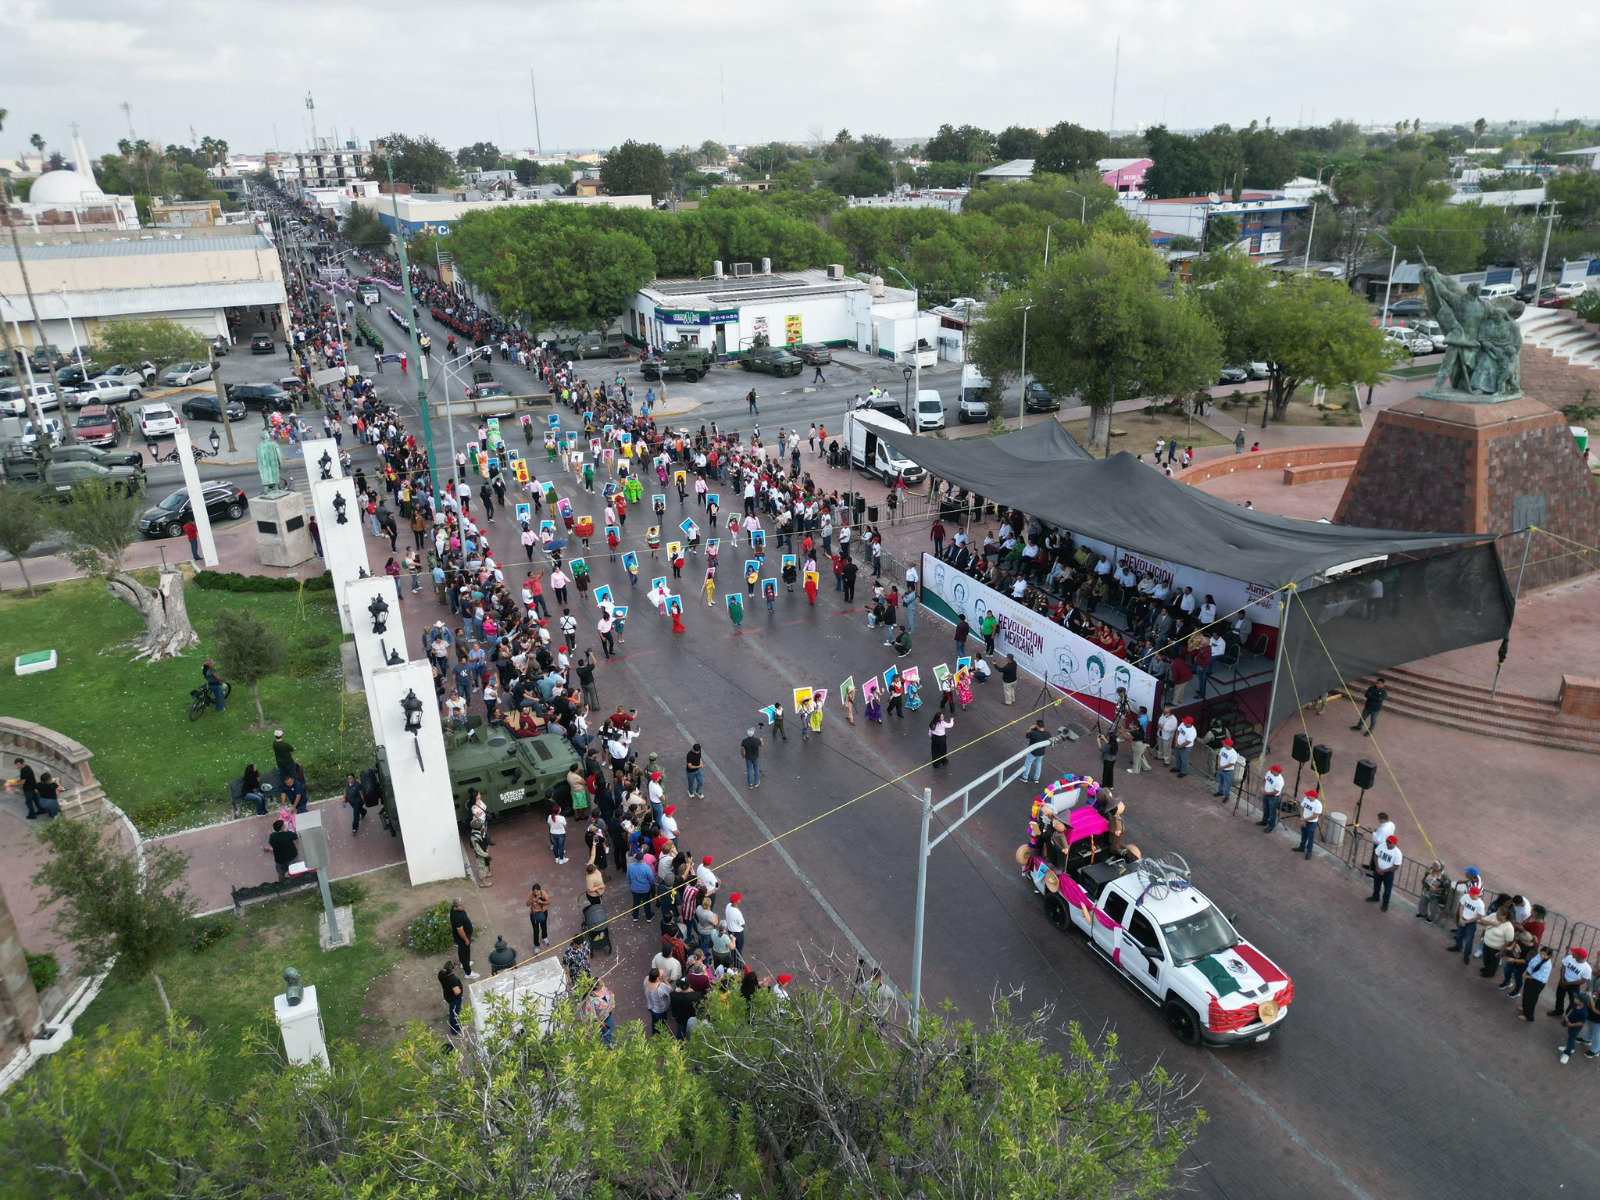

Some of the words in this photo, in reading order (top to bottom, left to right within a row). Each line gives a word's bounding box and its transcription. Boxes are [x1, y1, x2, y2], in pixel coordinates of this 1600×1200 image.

[1004, 630, 1034, 657] MEXICANA
[1378, 850, 1393, 864] SMN
[1566, 962, 1581, 976] SMN
